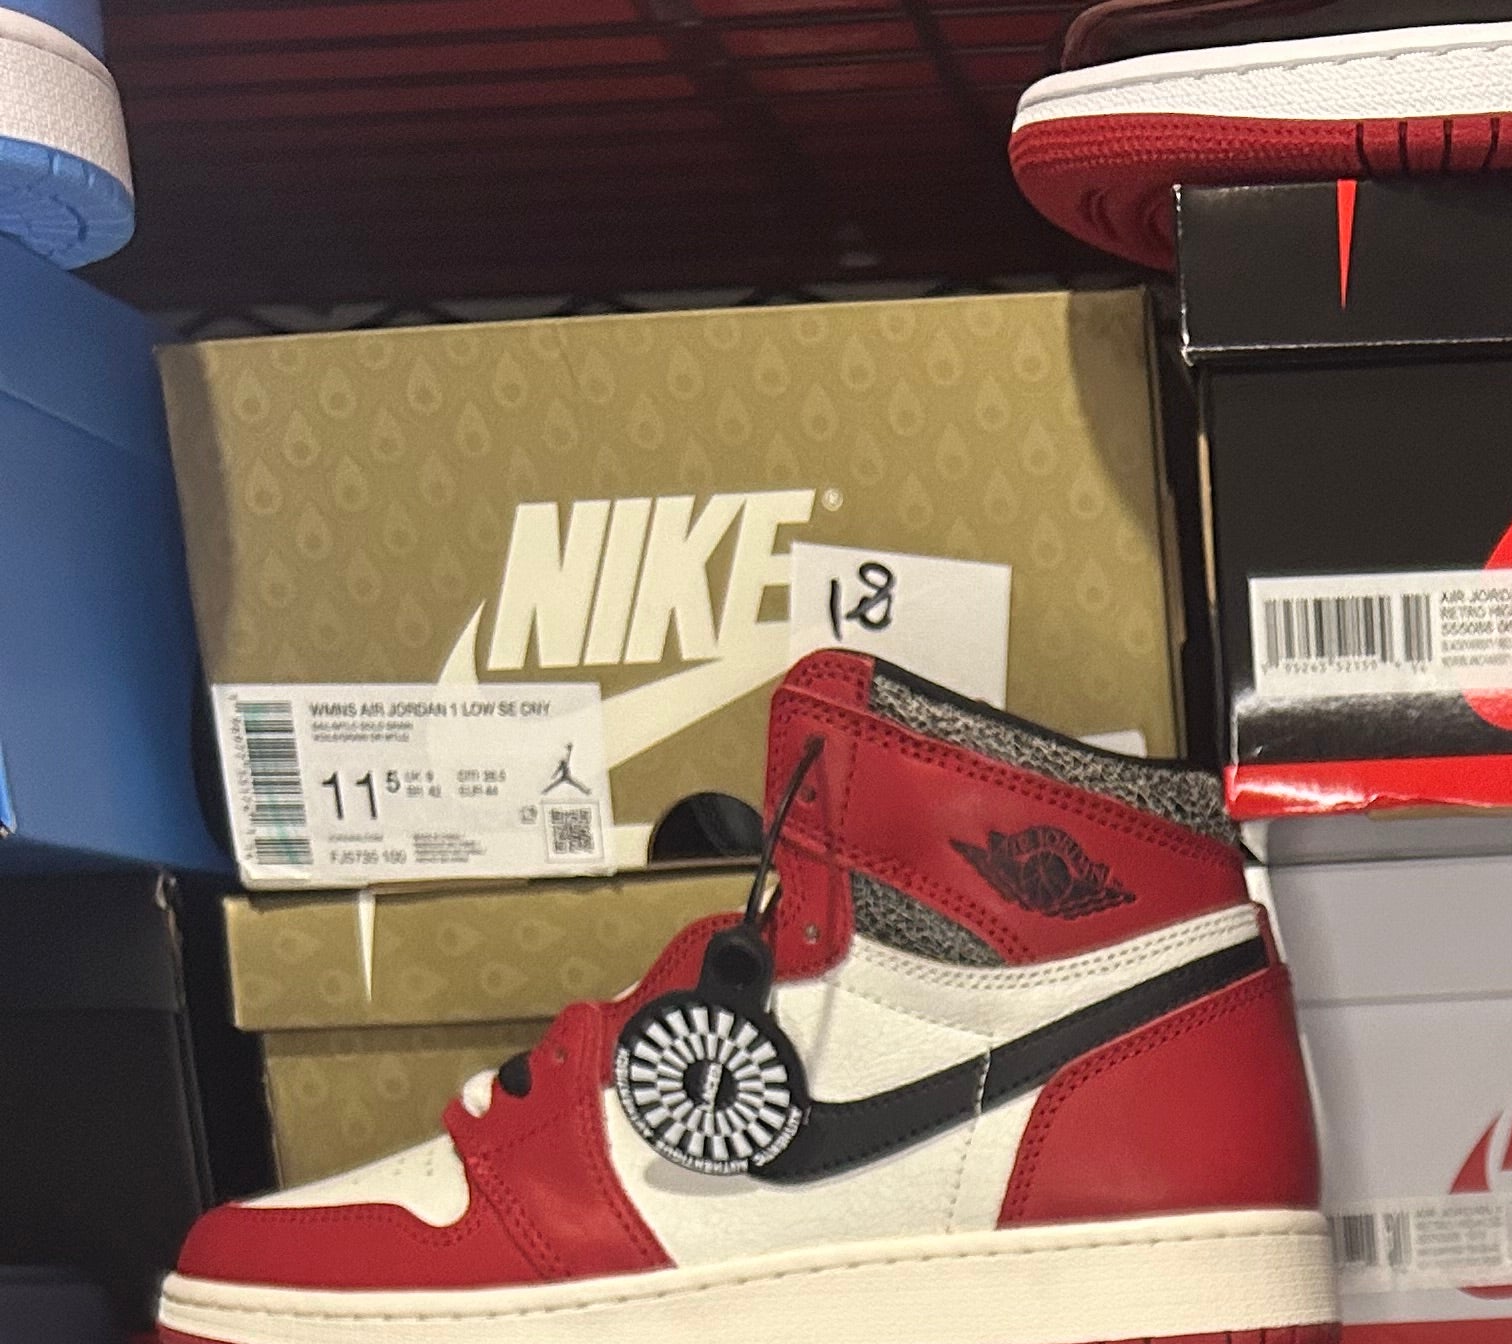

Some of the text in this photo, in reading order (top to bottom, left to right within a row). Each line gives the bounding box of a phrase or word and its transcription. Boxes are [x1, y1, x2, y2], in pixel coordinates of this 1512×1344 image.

[487, 489, 816, 671] NIKE
[831, 561, 896, 641] 18
[360, 701, 385, 717] AIR
[388, 701, 447, 718] JORDAN
[450, 700, 458, 716] 1
[462, 700, 495, 717] LOW
[499, 699, 516, 716] SE
